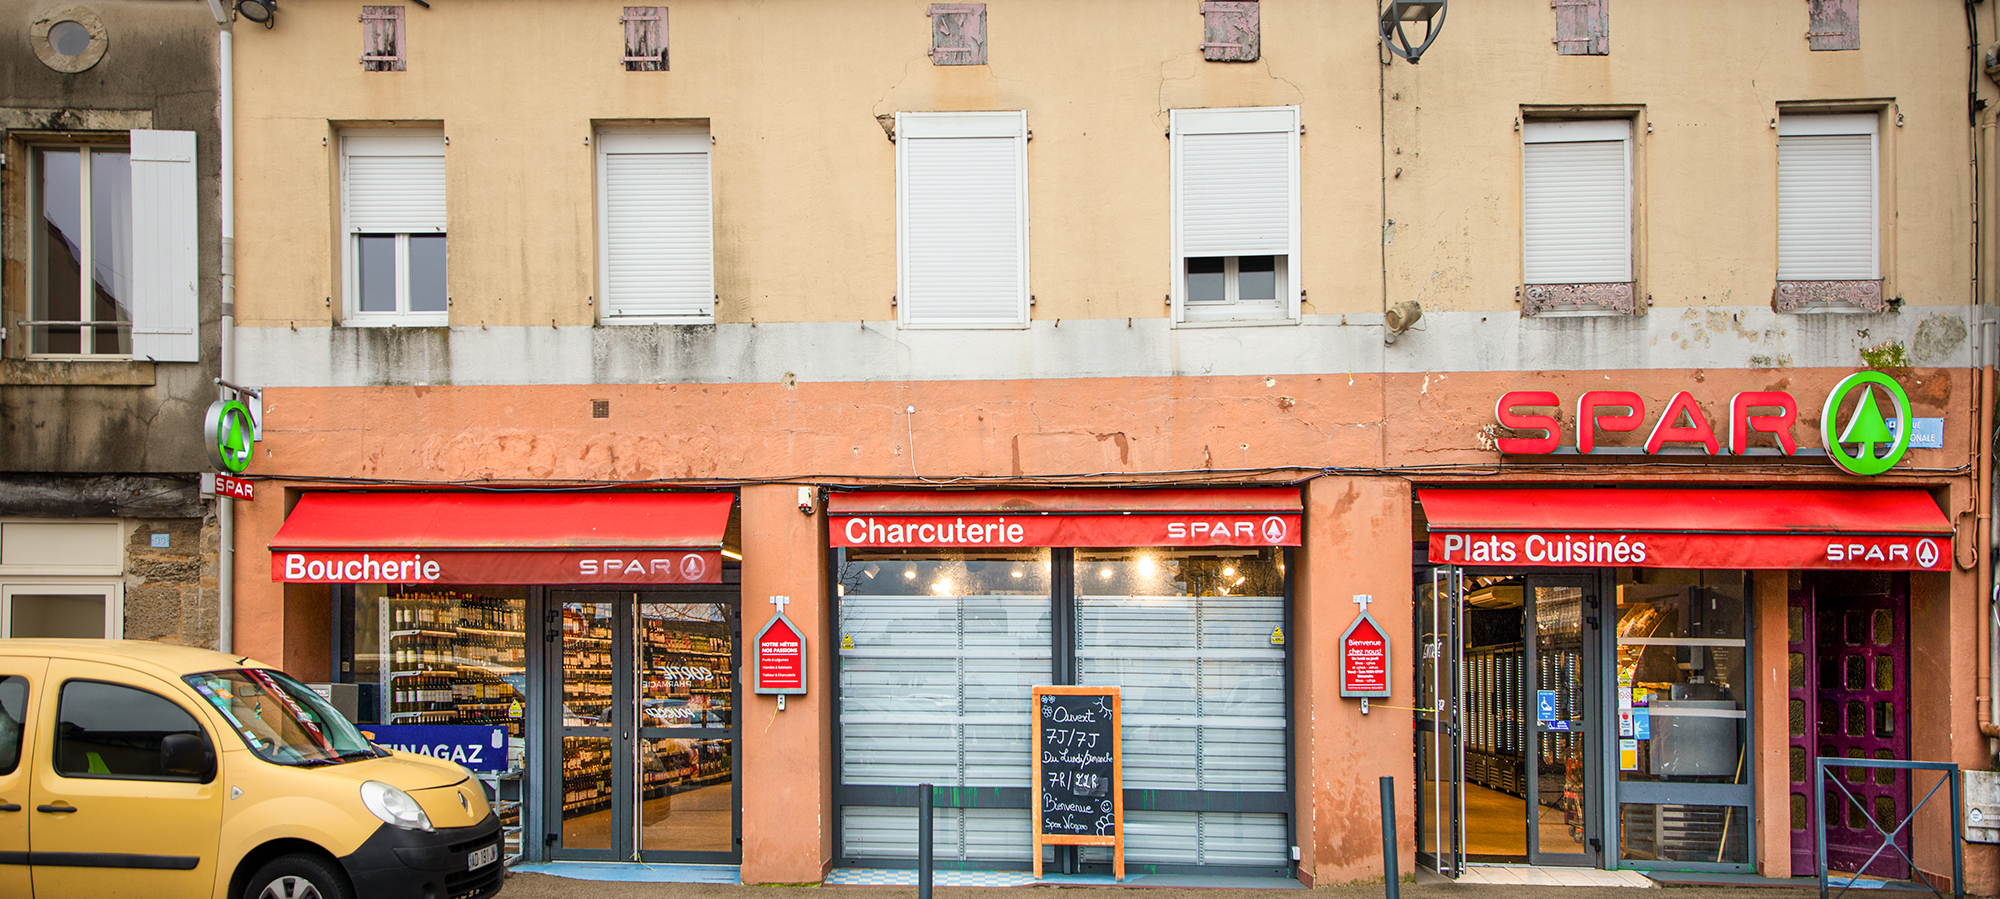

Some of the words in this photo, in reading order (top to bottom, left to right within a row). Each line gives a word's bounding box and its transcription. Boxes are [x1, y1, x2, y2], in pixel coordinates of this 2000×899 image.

[1494, 390, 1799, 457] SPAR
[215, 477, 254, 498] SPAR
[844, 517, 1024, 544] Charcuterie
[1167, 521, 1255, 539] SPAR
[1443, 534, 1516, 562] Plats
[1524, 534, 1646, 563] Cuisinés
[1826, 543, 1909, 562] SPAR
[285, 553, 441, 581] Boucherie
[578, 558, 671, 576] SPAR
[1053, 706, 1096, 723] Ouvert
[379, 744, 483, 764] NAGAZ
[1042, 750, 1060, 764] Du
